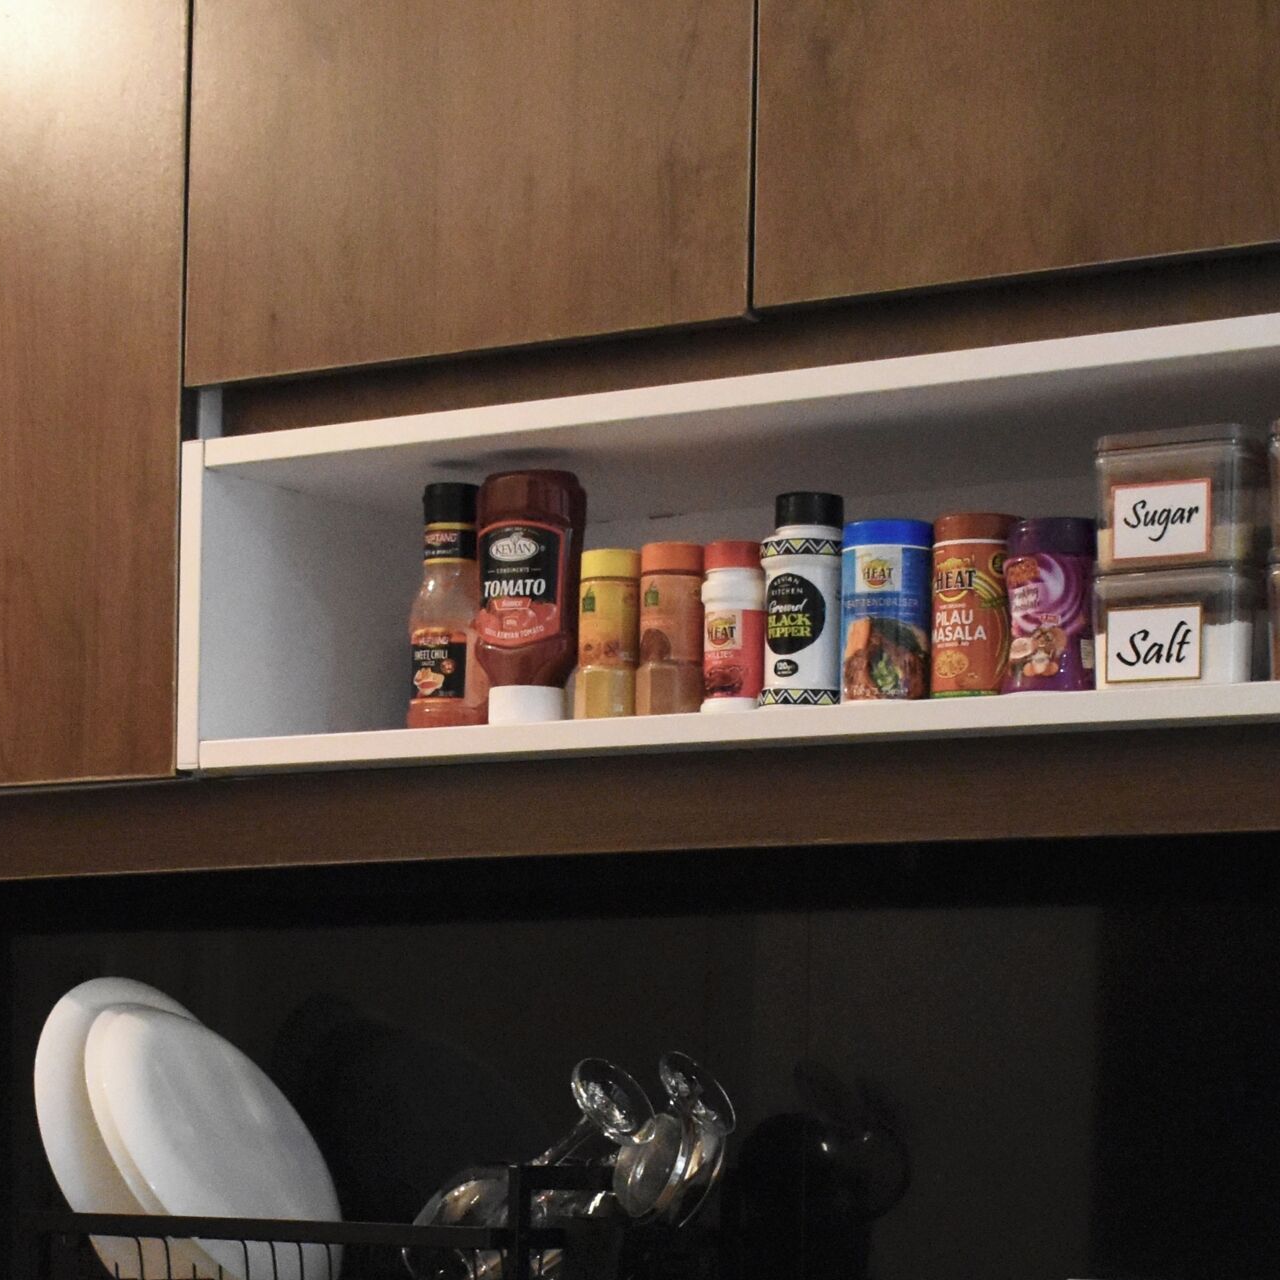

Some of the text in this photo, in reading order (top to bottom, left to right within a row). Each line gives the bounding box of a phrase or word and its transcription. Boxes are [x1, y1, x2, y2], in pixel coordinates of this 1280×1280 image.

[1124, 500, 1199, 542] Sugar
[495, 541, 532, 555] KEVIAN
[862, 567, 894, 581] HEAT
[935, 569, 976, 591] HEAT
[484, 578, 547, 598] TOMATO
[771, 587, 804, 597] KITCHEN
[767, 613, 812, 628] BLACK
[935, 608, 974, 629] PILAU
[707, 626, 736, 640] HEAT
[767, 626, 813, 640] PEPPER
[1116, 620, 1192, 667] Salt
